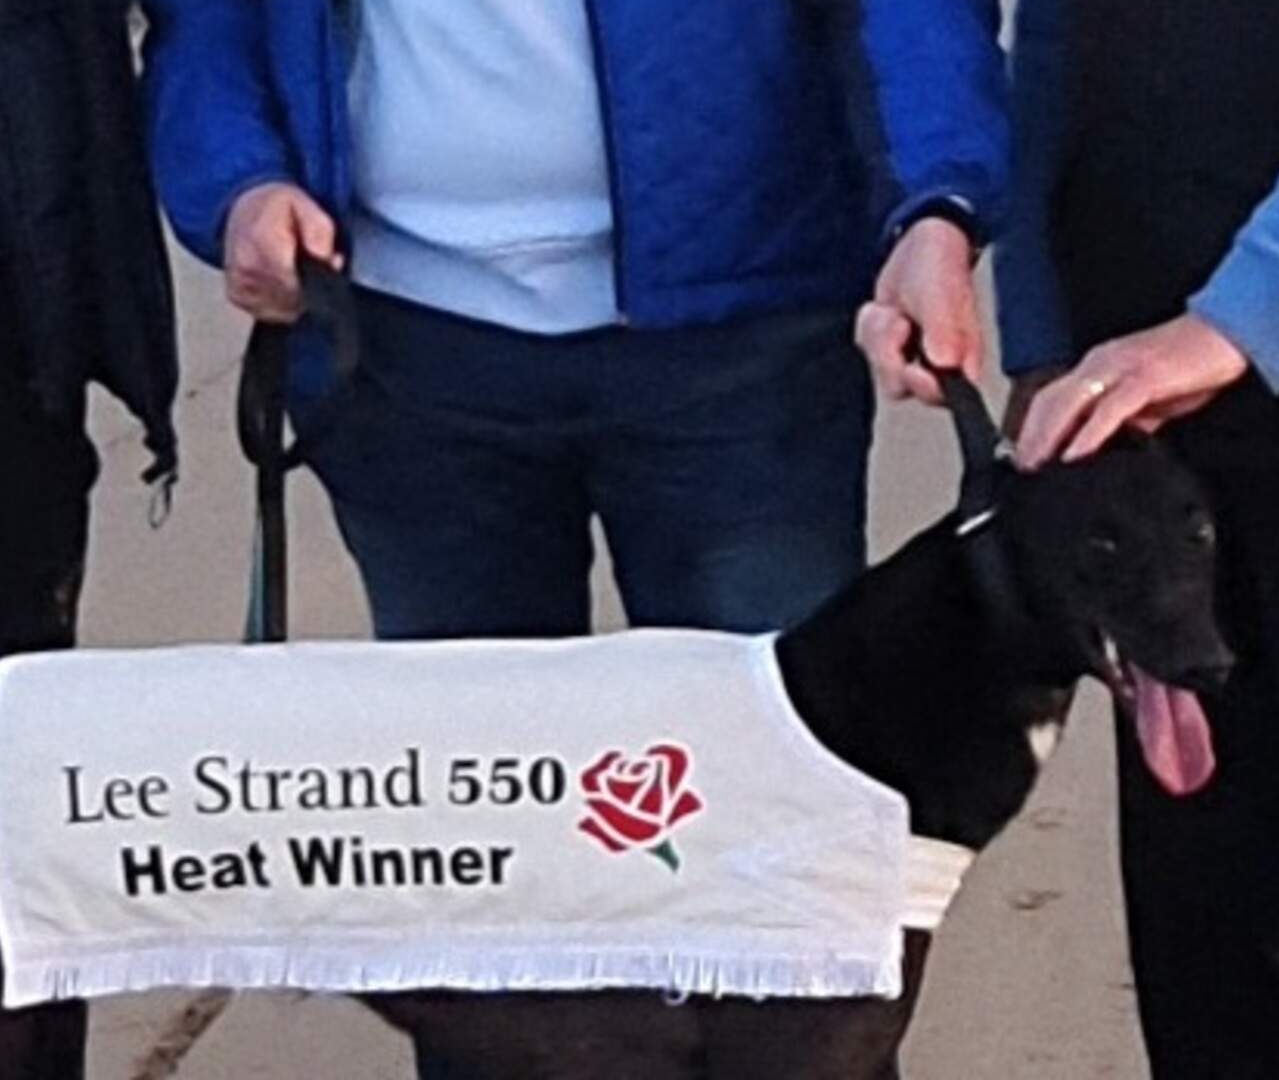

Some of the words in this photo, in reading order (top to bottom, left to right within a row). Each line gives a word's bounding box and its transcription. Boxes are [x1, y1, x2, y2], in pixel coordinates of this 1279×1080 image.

[64, 766, 169, 824] Lee
[193, 748, 422, 815] Strand
[448, 757, 567, 806] 550
[120, 842, 271, 897] Heat
[287, 837, 513, 887] Winner
